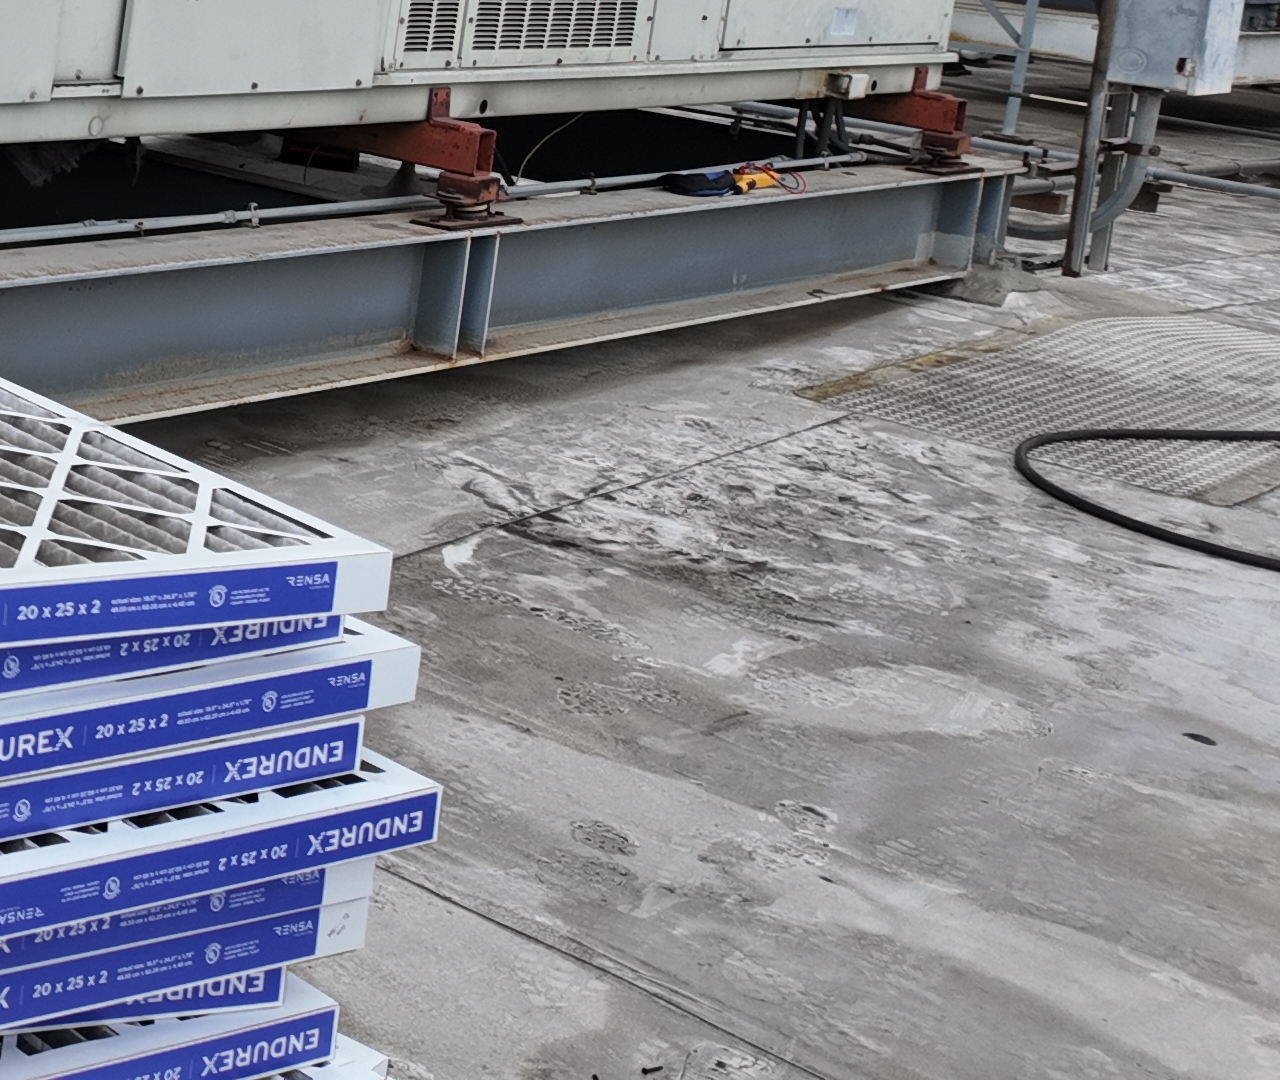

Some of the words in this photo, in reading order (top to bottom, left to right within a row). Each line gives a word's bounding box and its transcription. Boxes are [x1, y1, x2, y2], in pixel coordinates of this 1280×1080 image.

[285, 573, 331, 587] RENSA
[16, 605, 38, 621] 20
[41, 606, 52, 619] x
[54, 601, 75, 618] 25
[77, 603, 88, 616] x
[90, 599, 102, 615] 2
[131, 641, 140, 653] x
[143, 638, 159, 653] 25
[162, 636, 171, 647] x
[174, 633, 191, 647] 20
[119, 642, 129, 657] 2
[327, 672, 366, 687] RENSA
[94, 723, 114, 740] 20
[116, 724, 126, 735] x
[127, 717, 146, 733] 25
[148, 718, 157, 730] x
[159, 713, 169, 728] 2
[223, 740, 344, 783] ENDUREX
[154, 775, 172, 793] 25
[175, 774, 183, 786] x
[186, 770, 204, 785] 20
[131, 781, 141, 797] 2
[143, 780, 153, 792] x
[307, 810, 423, 856] ENDUREX
[240, 850, 257, 867] 25
[259, 848, 268, 860] x
[270, 844, 288, 860] 20
[218, 857, 227, 871] 2
[229, 854, 238, 866] x
[33, 930, 53, 943] 20
[56, 926, 66, 939] x
[68, 922, 87, 937] 25
[89, 920, 98, 932] x
[101, 917, 111, 930] 2
[272, 920, 314, 937] RENSA
[32, 982, 52, 998] 20
[54, 981, 64, 994] x
[66, 975, 84, 991] 25
[87, 974, 95, 986] x
[99, 970, 108, 984] 2
[201, 1028, 320, 1077] ENDUREX
[163, 1066, 182, 1080] 20
